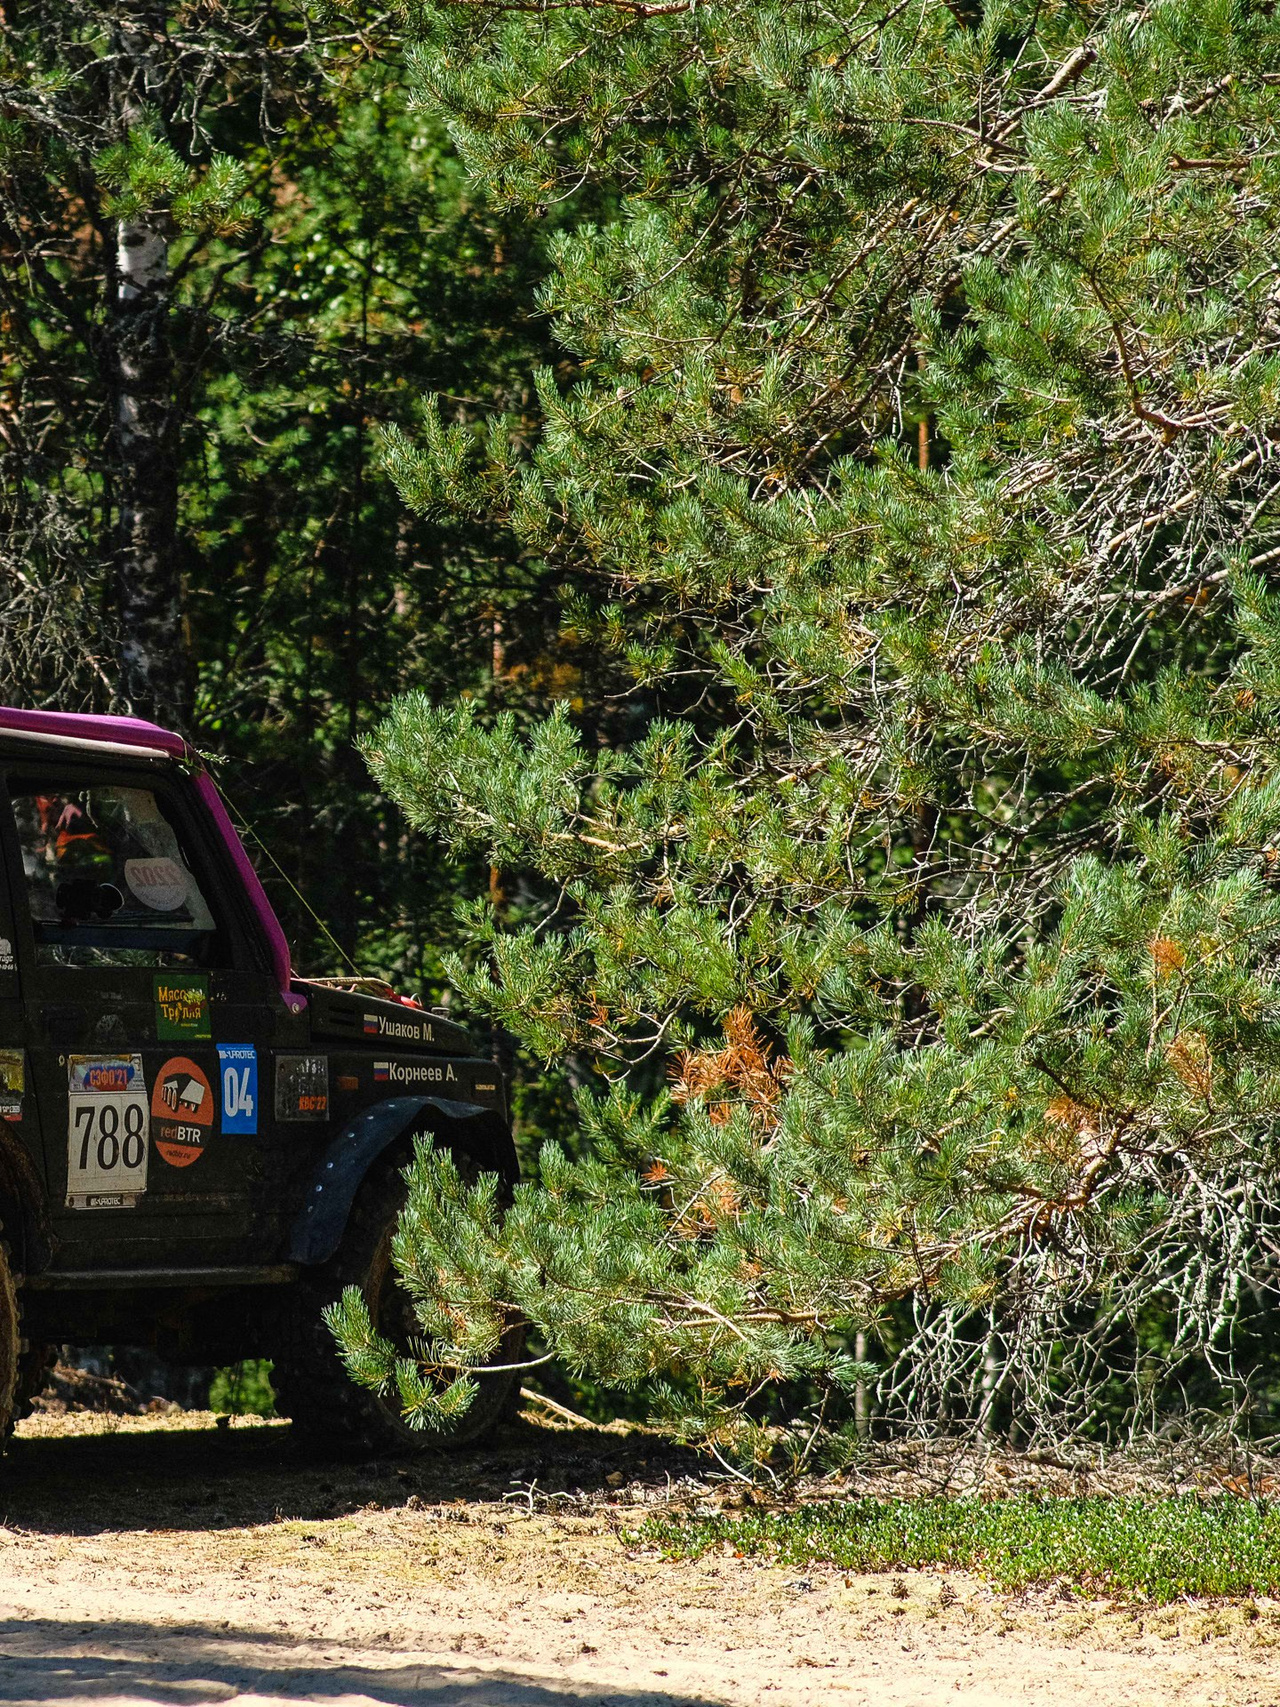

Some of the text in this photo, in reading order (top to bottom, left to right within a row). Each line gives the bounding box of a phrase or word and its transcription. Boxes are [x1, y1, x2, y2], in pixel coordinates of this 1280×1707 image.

[379, 1016, 435, 1042] Ушаков М.
[226, 1050, 255, 1059] SUPROTEC
[389, 1062, 458, 1085] Корнеев А.
[224, 1067, 254, 1117] 04
[75, 1104, 145, 1170] 788
[160, 1126, 201, 1143] redBTR
